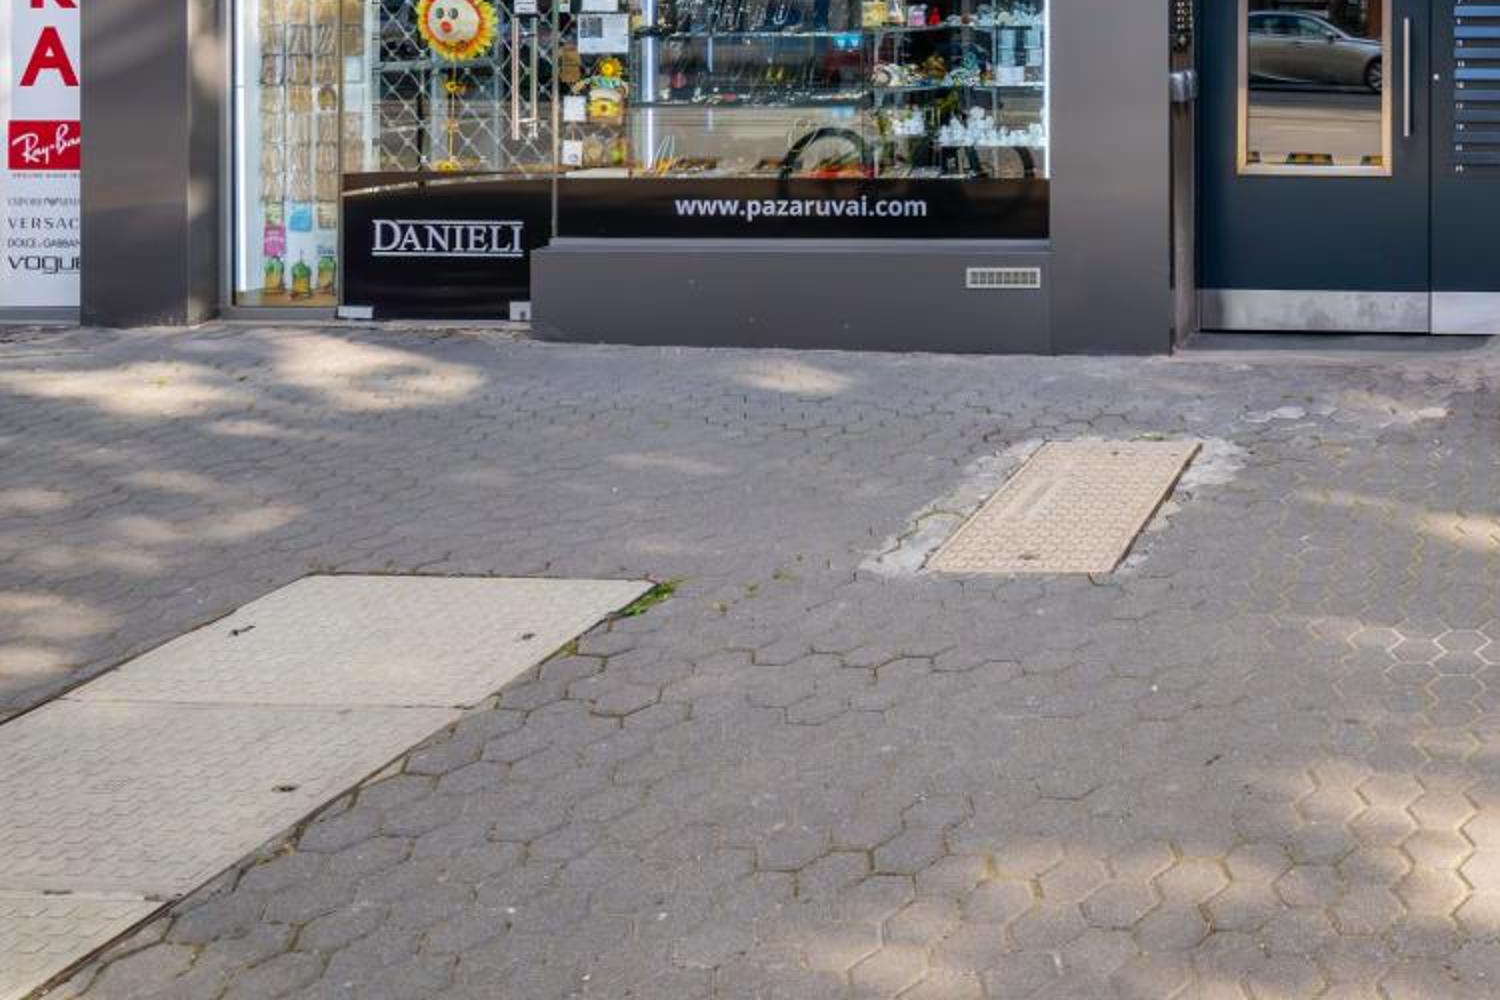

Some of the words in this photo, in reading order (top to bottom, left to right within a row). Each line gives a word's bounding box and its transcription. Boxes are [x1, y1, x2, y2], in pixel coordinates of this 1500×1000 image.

[675, 195, 927, 222] www.pazaruvai.com
[372, 219, 524, 254] DANIELI
[8, 255, 80, 274] vogu
